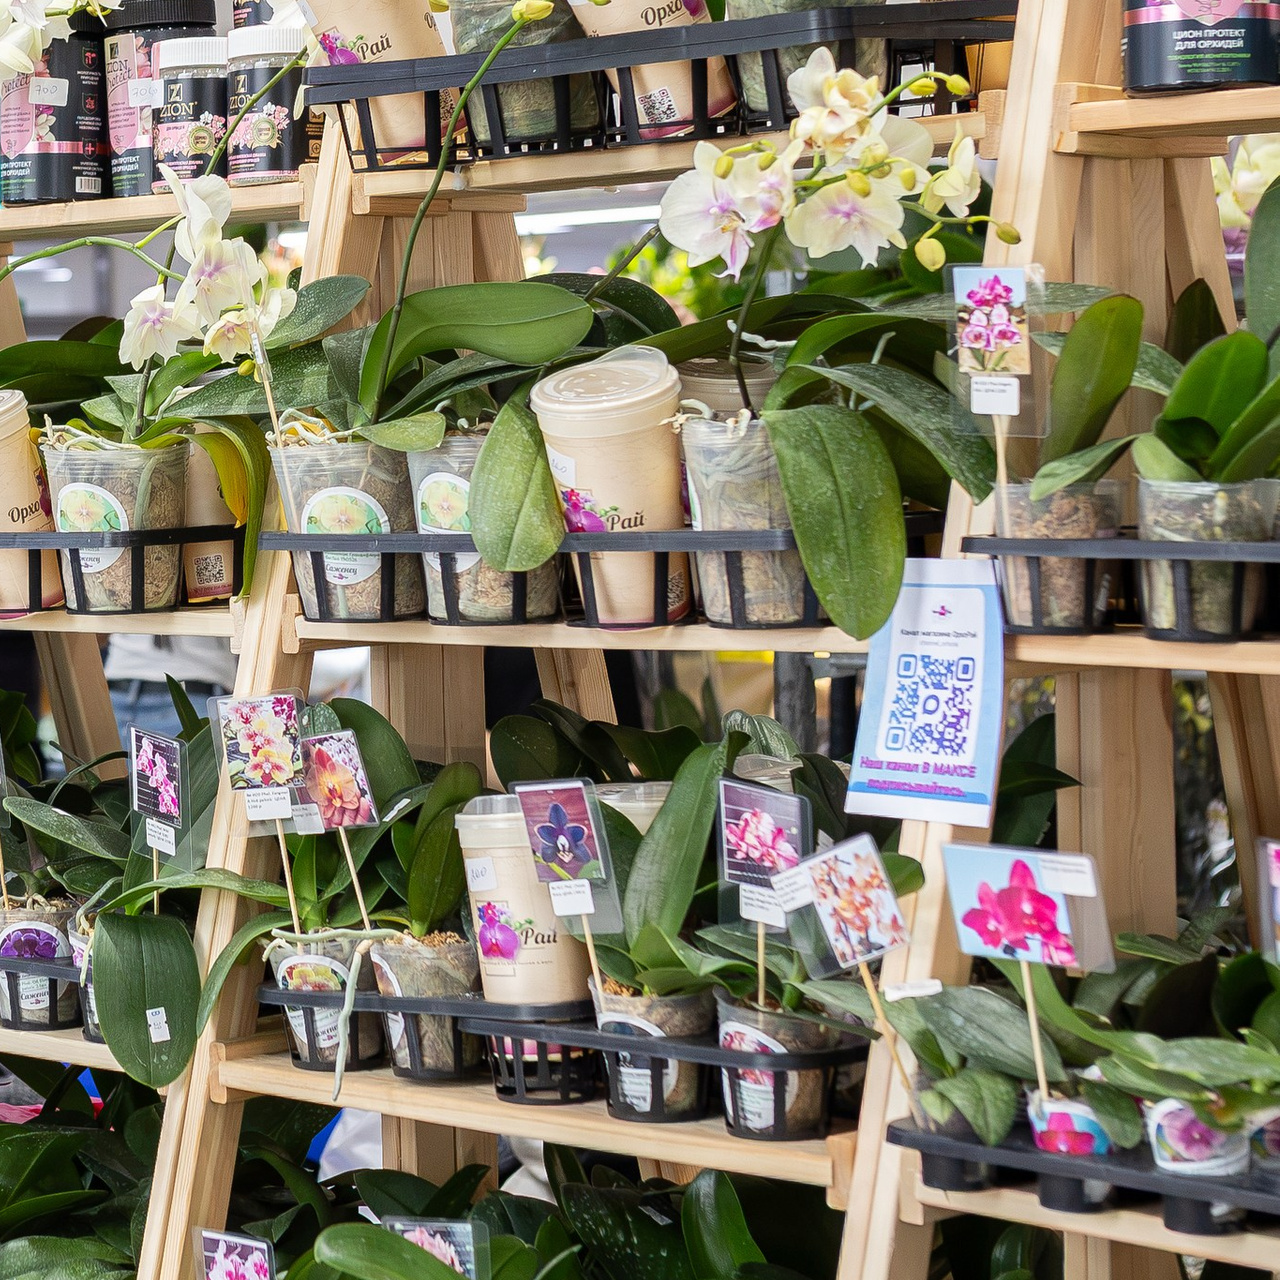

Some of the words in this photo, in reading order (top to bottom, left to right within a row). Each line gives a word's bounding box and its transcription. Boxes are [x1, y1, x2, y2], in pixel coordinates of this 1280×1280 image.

[641, 0, 683, 27] Орхо
[1173, 29, 1202, 40] ЦИОН
[1204, 28, 1246, 38] ПРОТЕКТ
[356, 33, 393, 61] Рай
[1175, 41, 1196, 51] ДЛЯ
[1197, 38, 1244, 49] ОРХИДЕЙ
[35, 84, 58, 95] 700
[160, 103, 194, 118] ZION
[7, 500, 40, 524] Орхо
[606, 510, 645, 531] Рай
[80, 554, 101, 564] женец
[325, 563, 358, 575] Саженец
[860, 755, 883, 770] Наш
[933, 762, 978, 779] МАКСЕ
